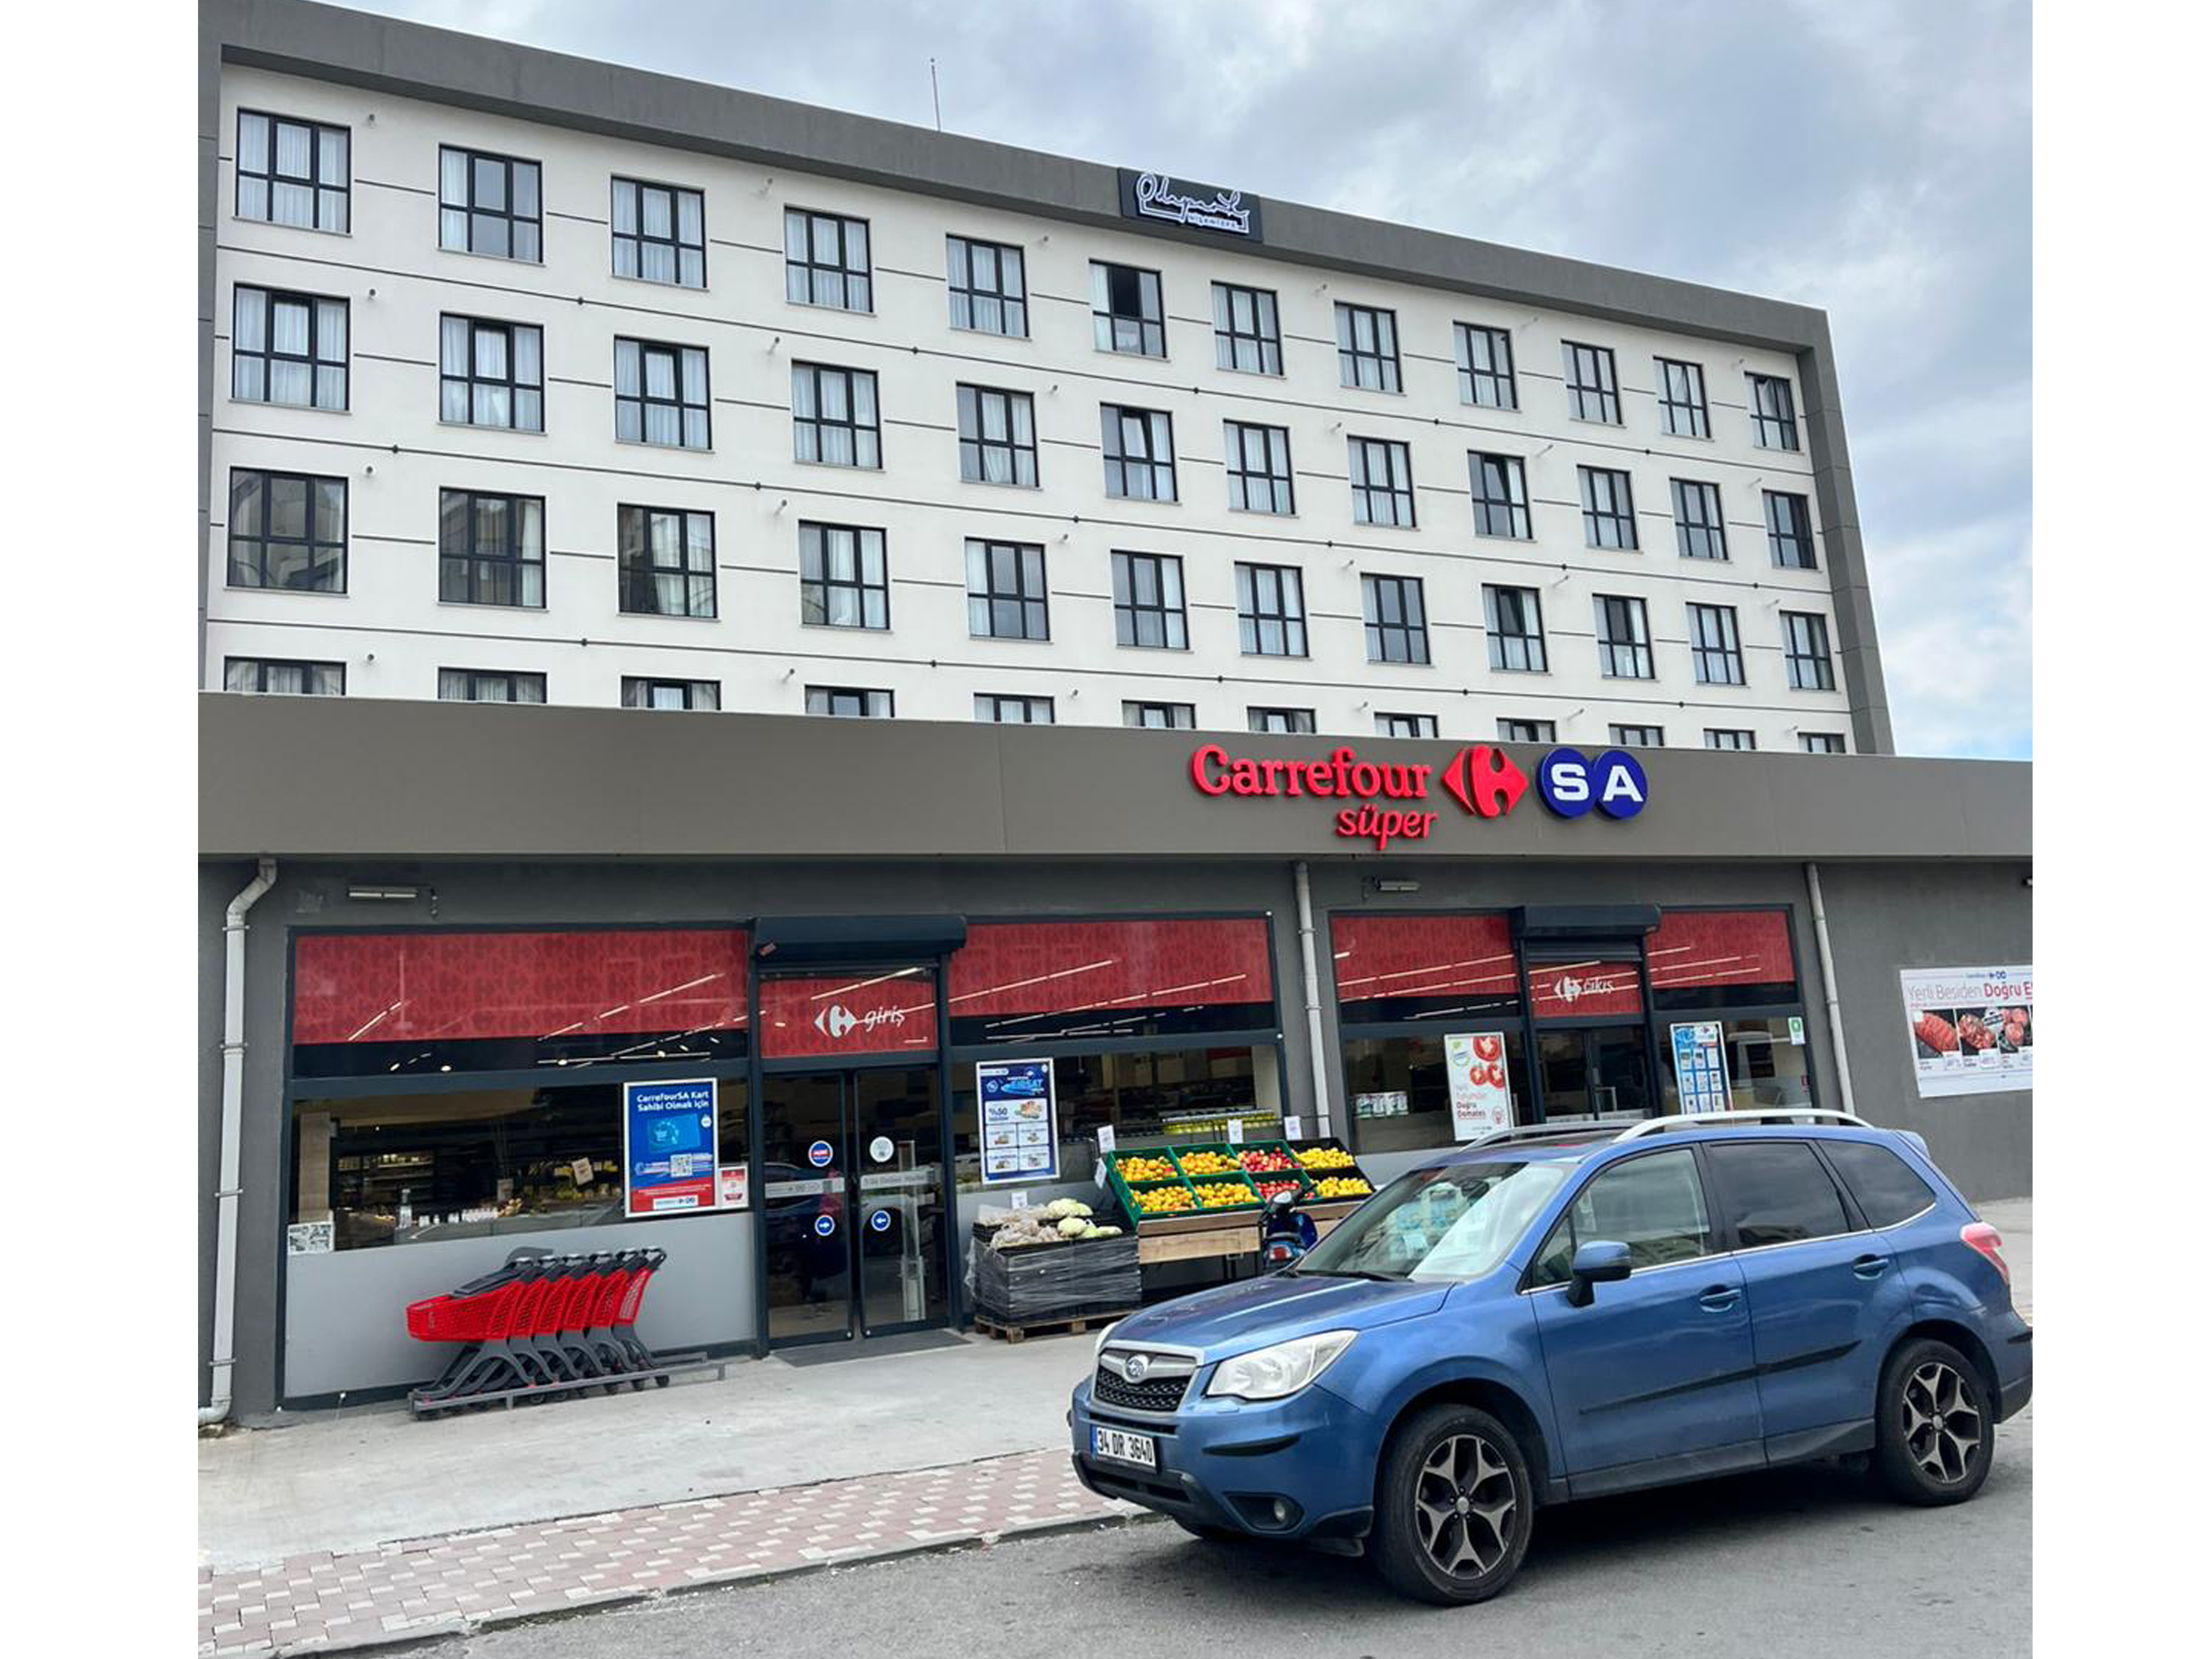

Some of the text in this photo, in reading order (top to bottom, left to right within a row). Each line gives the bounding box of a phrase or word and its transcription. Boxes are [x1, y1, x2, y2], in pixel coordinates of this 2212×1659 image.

[1191, 744, 1432, 800] Carrefour
[1336, 803, 1437, 850] süper
[1984, 981, 2021, 1000] Doğru
[864, 1005, 905, 1032] giriş
[636, 1092, 689, 1103] CarrefourSA
[637, 1103, 663, 1111] Sahibi
[665, 1101, 693, 1109] Olmak
[1098, 1430, 1153, 1463] 34 DR 3640
